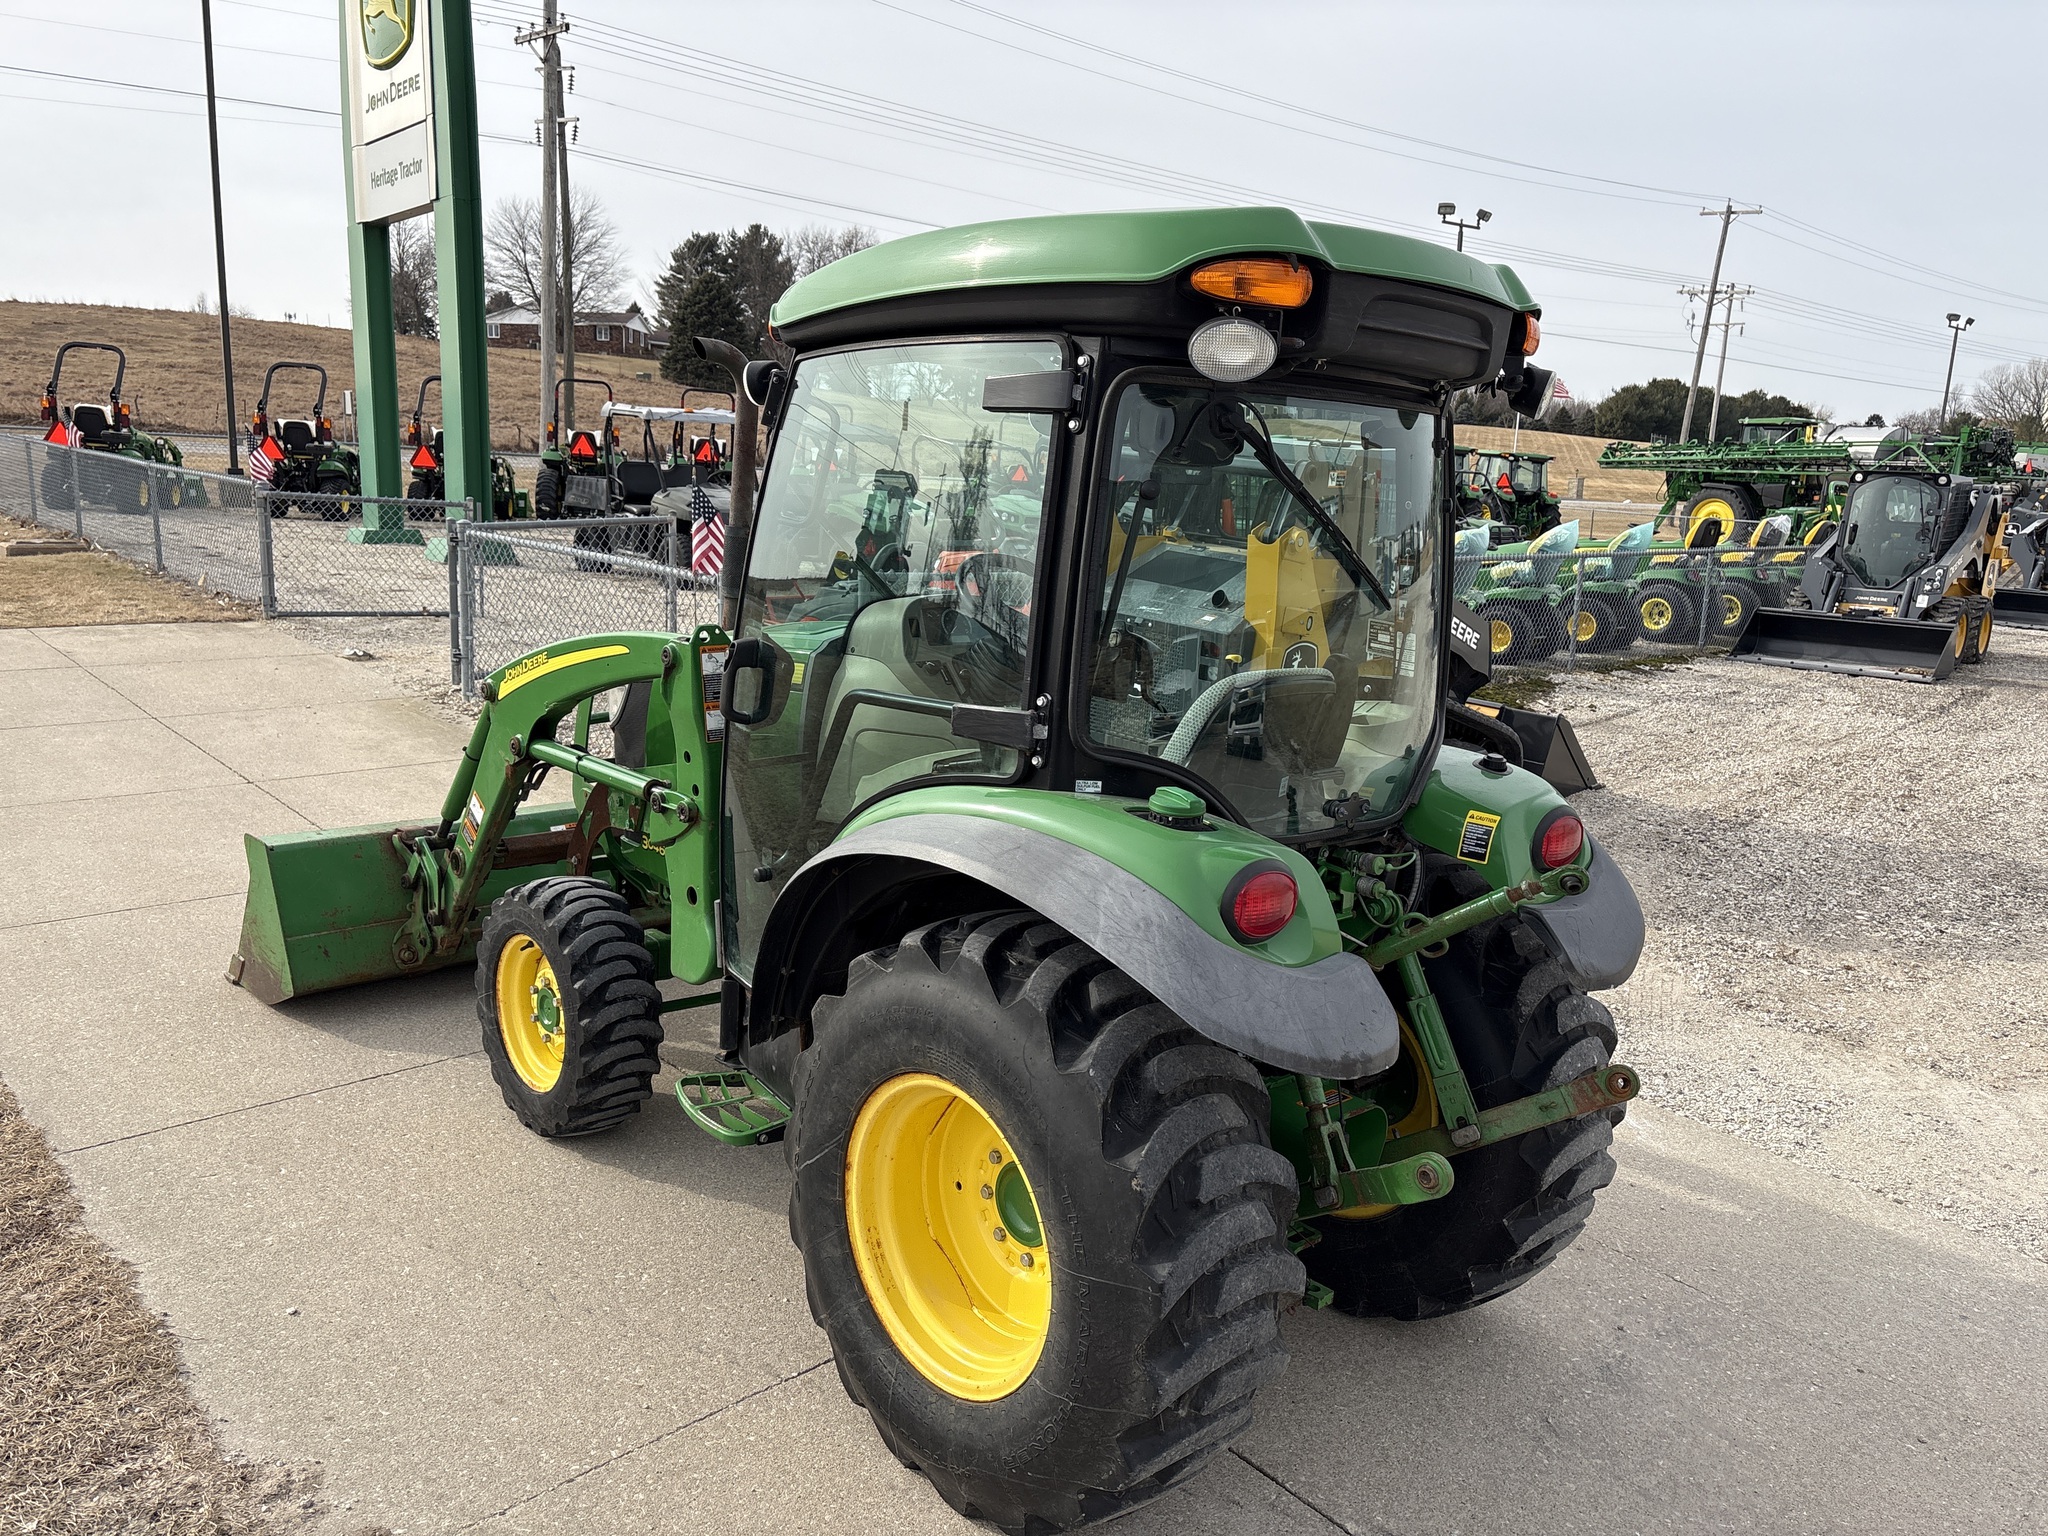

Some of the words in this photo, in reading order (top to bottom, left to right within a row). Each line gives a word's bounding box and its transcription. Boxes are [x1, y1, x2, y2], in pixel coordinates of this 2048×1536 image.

[365, 88, 389, 114] JOHN
[389, 73, 421, 103] DEERE
[370, 168, 399, 190] Heritage
[398, 158, 423, 180] Tractor
[1450, 616, 1481, 650] EERE
[503, 663, 523, 683] JOHN
[522, 651, 549, 673] DEERE
[1475, 815, 1498, 823] CAUTION
